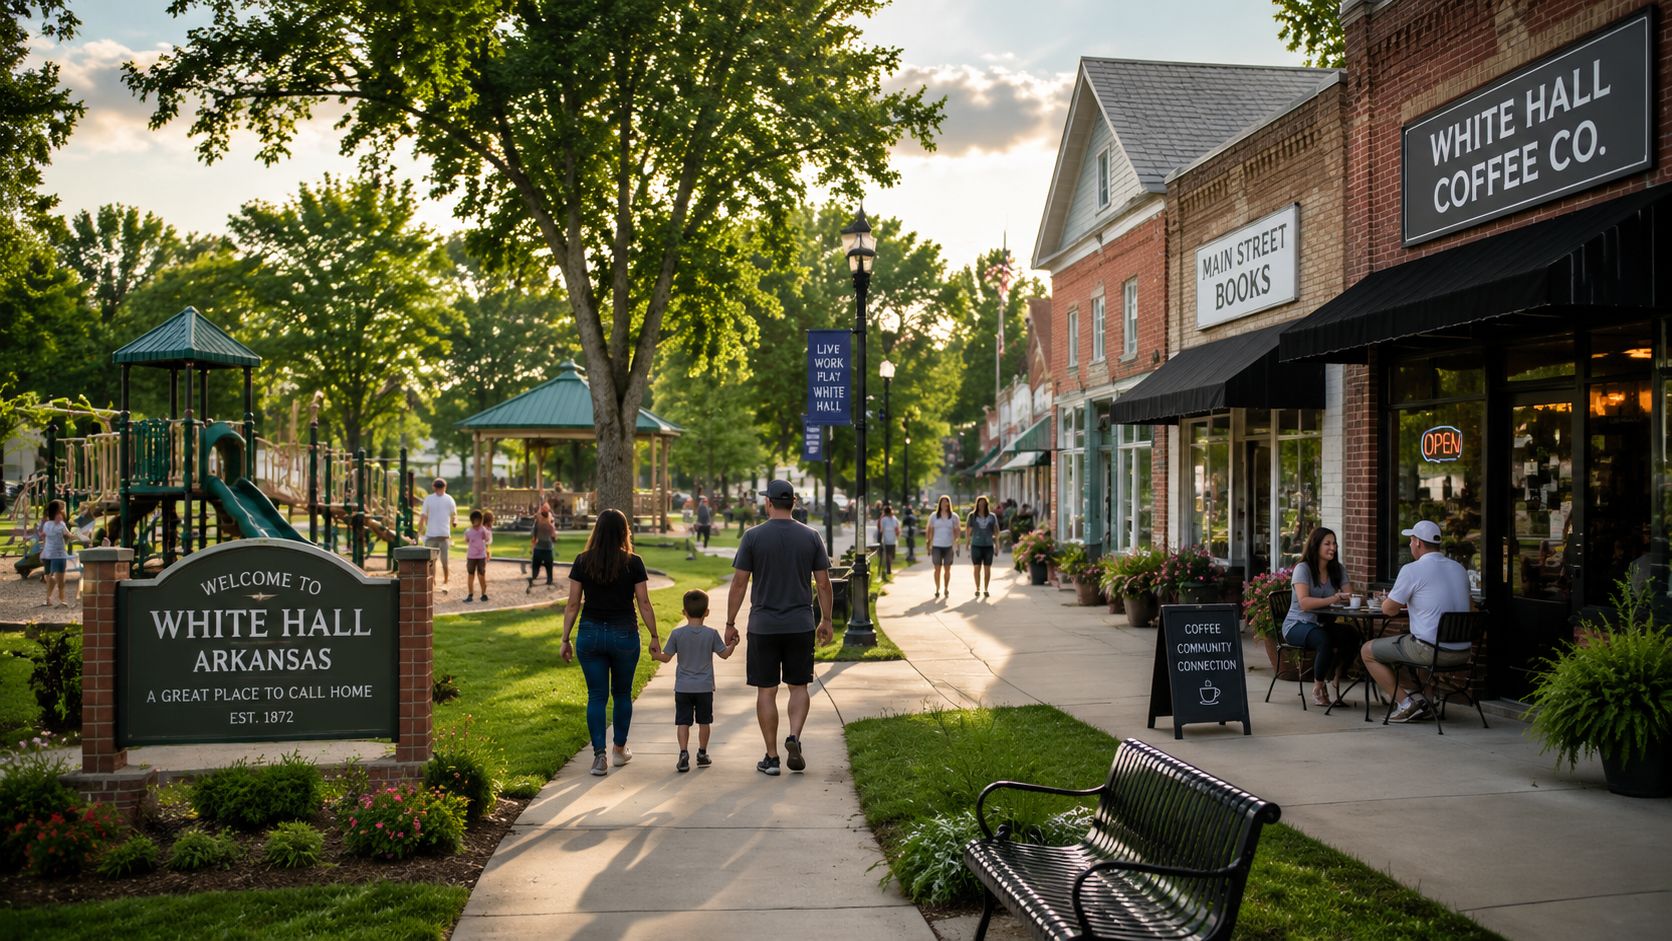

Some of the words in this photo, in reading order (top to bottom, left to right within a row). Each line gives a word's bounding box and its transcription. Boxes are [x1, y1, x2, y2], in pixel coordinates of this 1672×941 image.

[1430, 98, 1515, 166] WHITE
[1525, 59, 1611, 128] HALL
[1433, 141, 1538, 214] COFFEE
[1549, 120, 1606, 171] CO.
[1202, 247, 1232, 280] MAIN
[1237, 223, 1287, 265] STREET
[1215, 264, 1271, 310] BOOKS
[817, 344, 840, 354] LIVE
[814, 358, 844, 368] WORK
[813, 386, 845, 398] WHITE
[816, 401, 842, 411] HALL
[1424, 432, 1461, 455] OPEN
[200, 571, 293, 596] WELCOME
[299, 575, 322, 595] TO
[149, 609, 268, 639] WHITE
[281, 608, 372, 637] HALL
[1185, 624, 1221, 634] COFFEE
[1177, 642, 1232, 653] COMMUNITY
[193, 648, 331, 673] ARKANSAS
[1177, 660, 1237, 671] CONNECTION
[146, 691, 157, 703] A
[161, 688, 209, 703] GREAT
[214, 686, 259, 701] PLACE
[264, 686, 284, 699] TO
[289, 685, 326, 699] CALL
[330, 685, 373, 698] HOME
[229, 712, 259, 725] EST.
[263, 711, 295, 724] 1872
